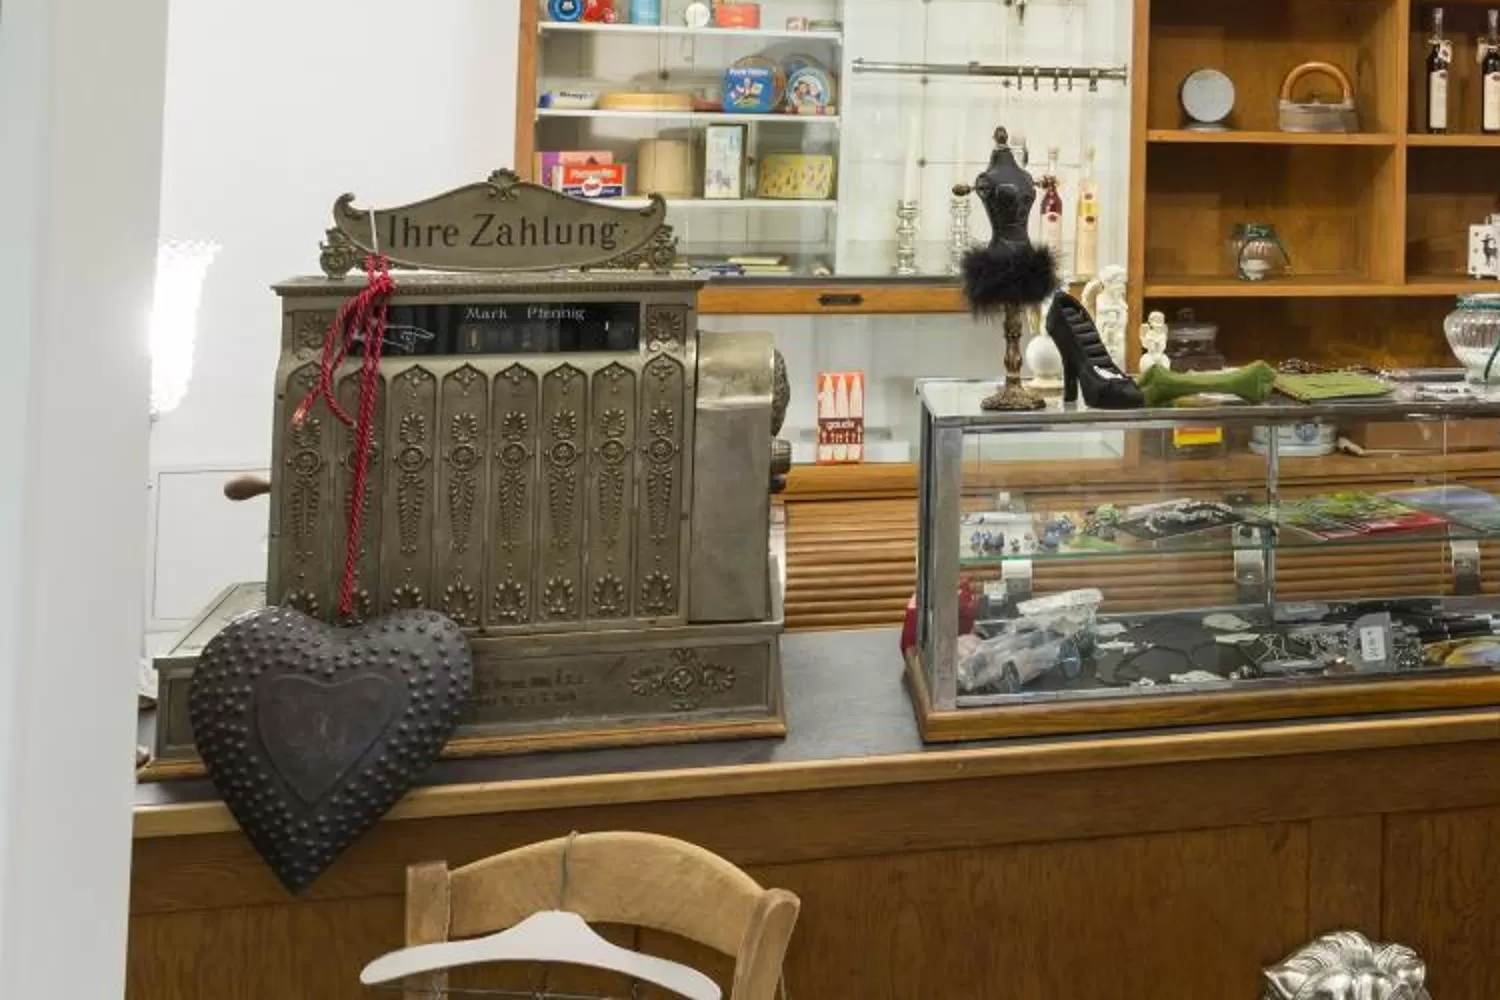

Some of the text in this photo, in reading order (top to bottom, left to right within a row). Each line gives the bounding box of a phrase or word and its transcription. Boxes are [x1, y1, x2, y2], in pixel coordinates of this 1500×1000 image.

[389, 213, 619, 250] Ihre Zahlung
[465, 307, 586, 321] Mark Pfennig
